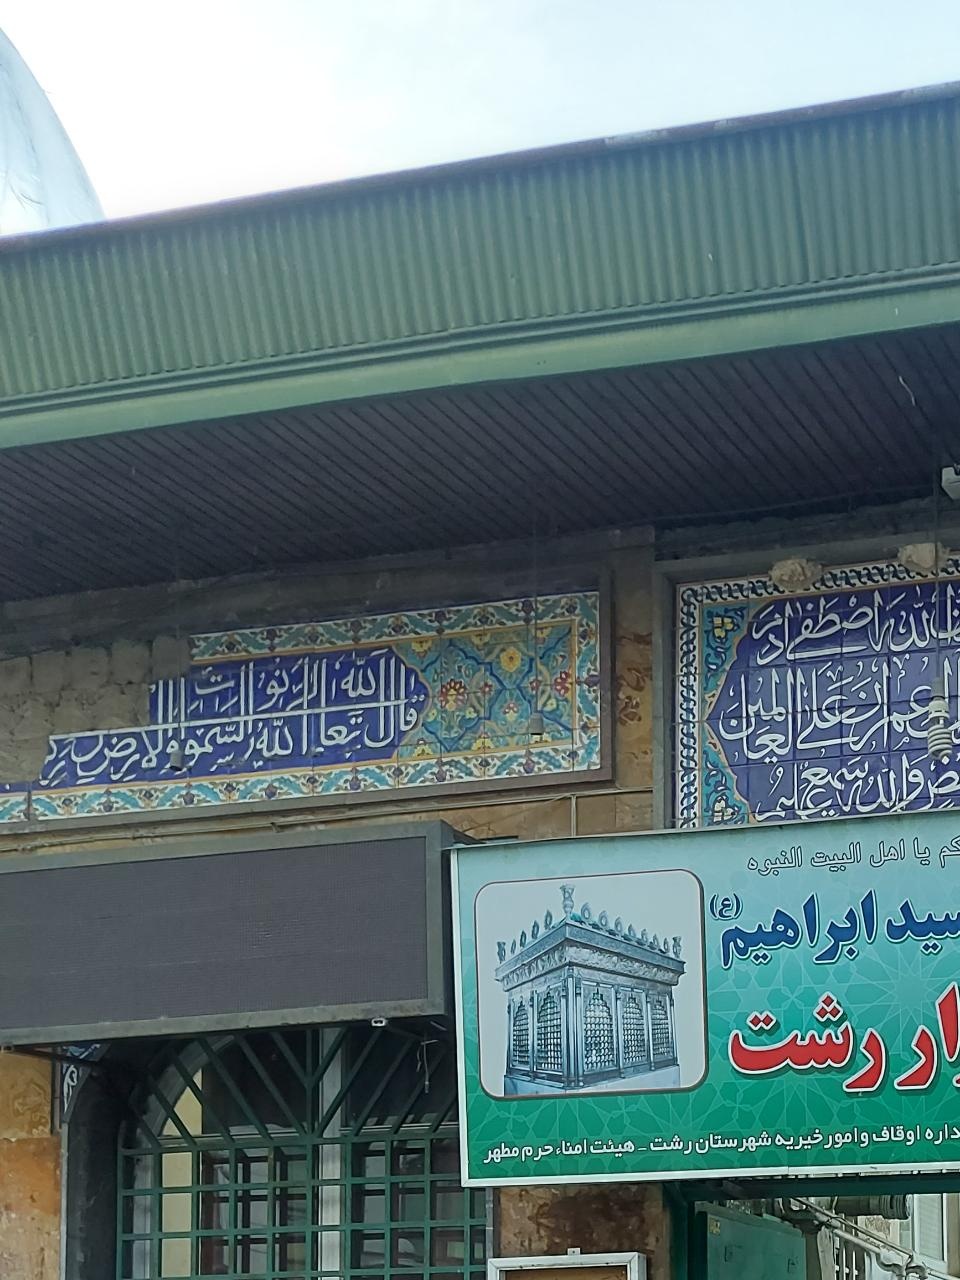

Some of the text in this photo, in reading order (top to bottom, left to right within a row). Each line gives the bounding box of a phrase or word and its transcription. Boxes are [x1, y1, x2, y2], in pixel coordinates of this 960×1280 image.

[748, 847, 803, 876] النبوه
[811, 842, 861, 873] البیت
[869, 839, 905, 868] اهل
[912, 837, 930, 867] یا
[720, 889, 878, 968] ابراهیم
[728, 991, 888, 1092] رشت
[556, 1139, 588, 1156] امناء
[650, 1133, 693, 1155] رشت
[696, 1130, 773, 1155] شهرستان
[775, 1128, 822, 1151] خیریه
[872, 1125, 920, 1146] اوقاف
[483, 1143, 520, 1164] مطهر
[521, 1144, 554, 1163] حرم
[590, 1138, 635, 1158] هیئت
